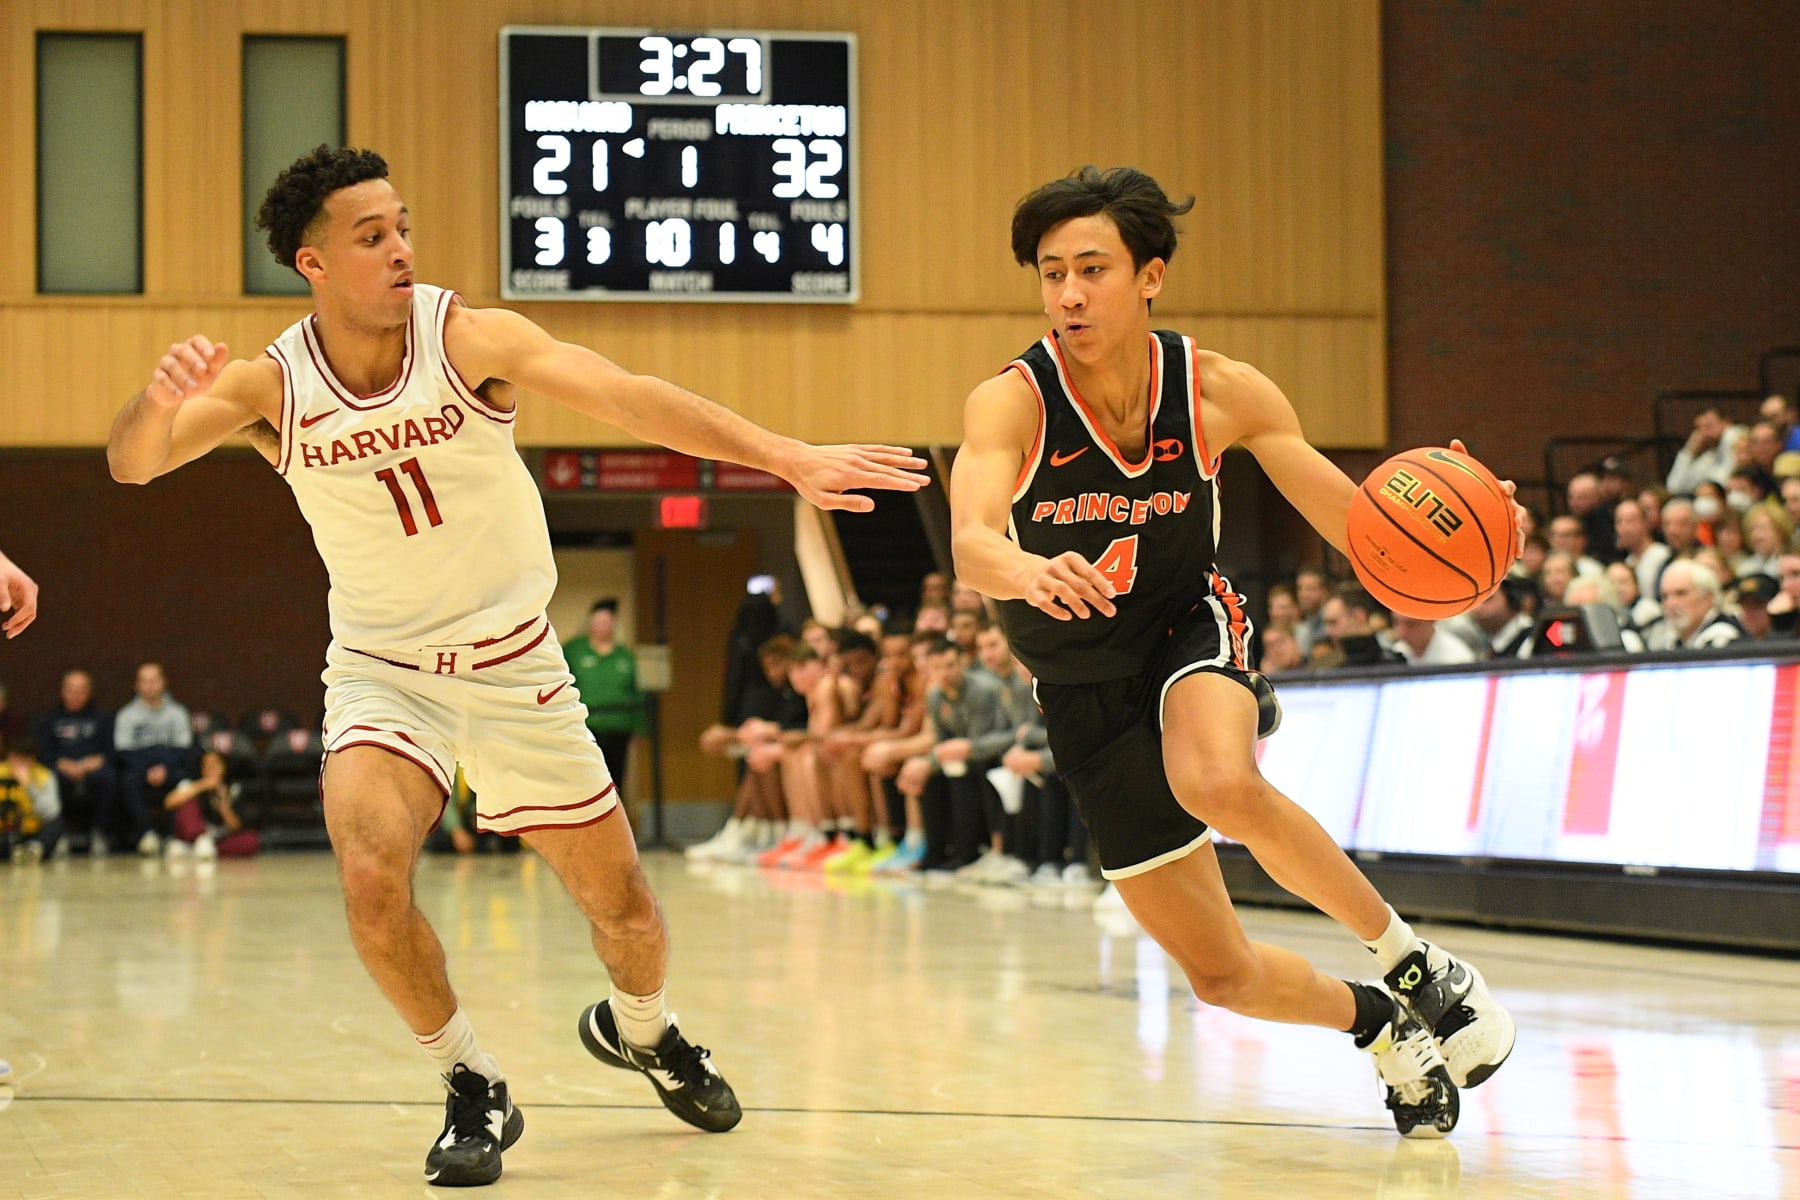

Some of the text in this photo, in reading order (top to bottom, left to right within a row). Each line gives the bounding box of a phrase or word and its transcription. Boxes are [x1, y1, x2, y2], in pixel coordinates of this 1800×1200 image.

[639, 37, 762, 96] 3:27
[682, 145, 698, 188] 1
[772, 138, 843, 198] 32
[535, 216, 565, 266] 3
[587, 227, 611, 264] 3
[646, 218, 691, 267] 10
[719, 222, 735, 264] 1
[753, 231, 780, 263] 4
[811, 223, 844, 266] 4
[300, 404, 465, 468] HARVARD
[374, 456, 444, 537] 11
[1379, 487, 1448, 544] CHAMPIONP
[1384, 468, 1464, 539] ELITE
[1091, 533, 1138, 596] 4
[435, 652, 458, 675] H
